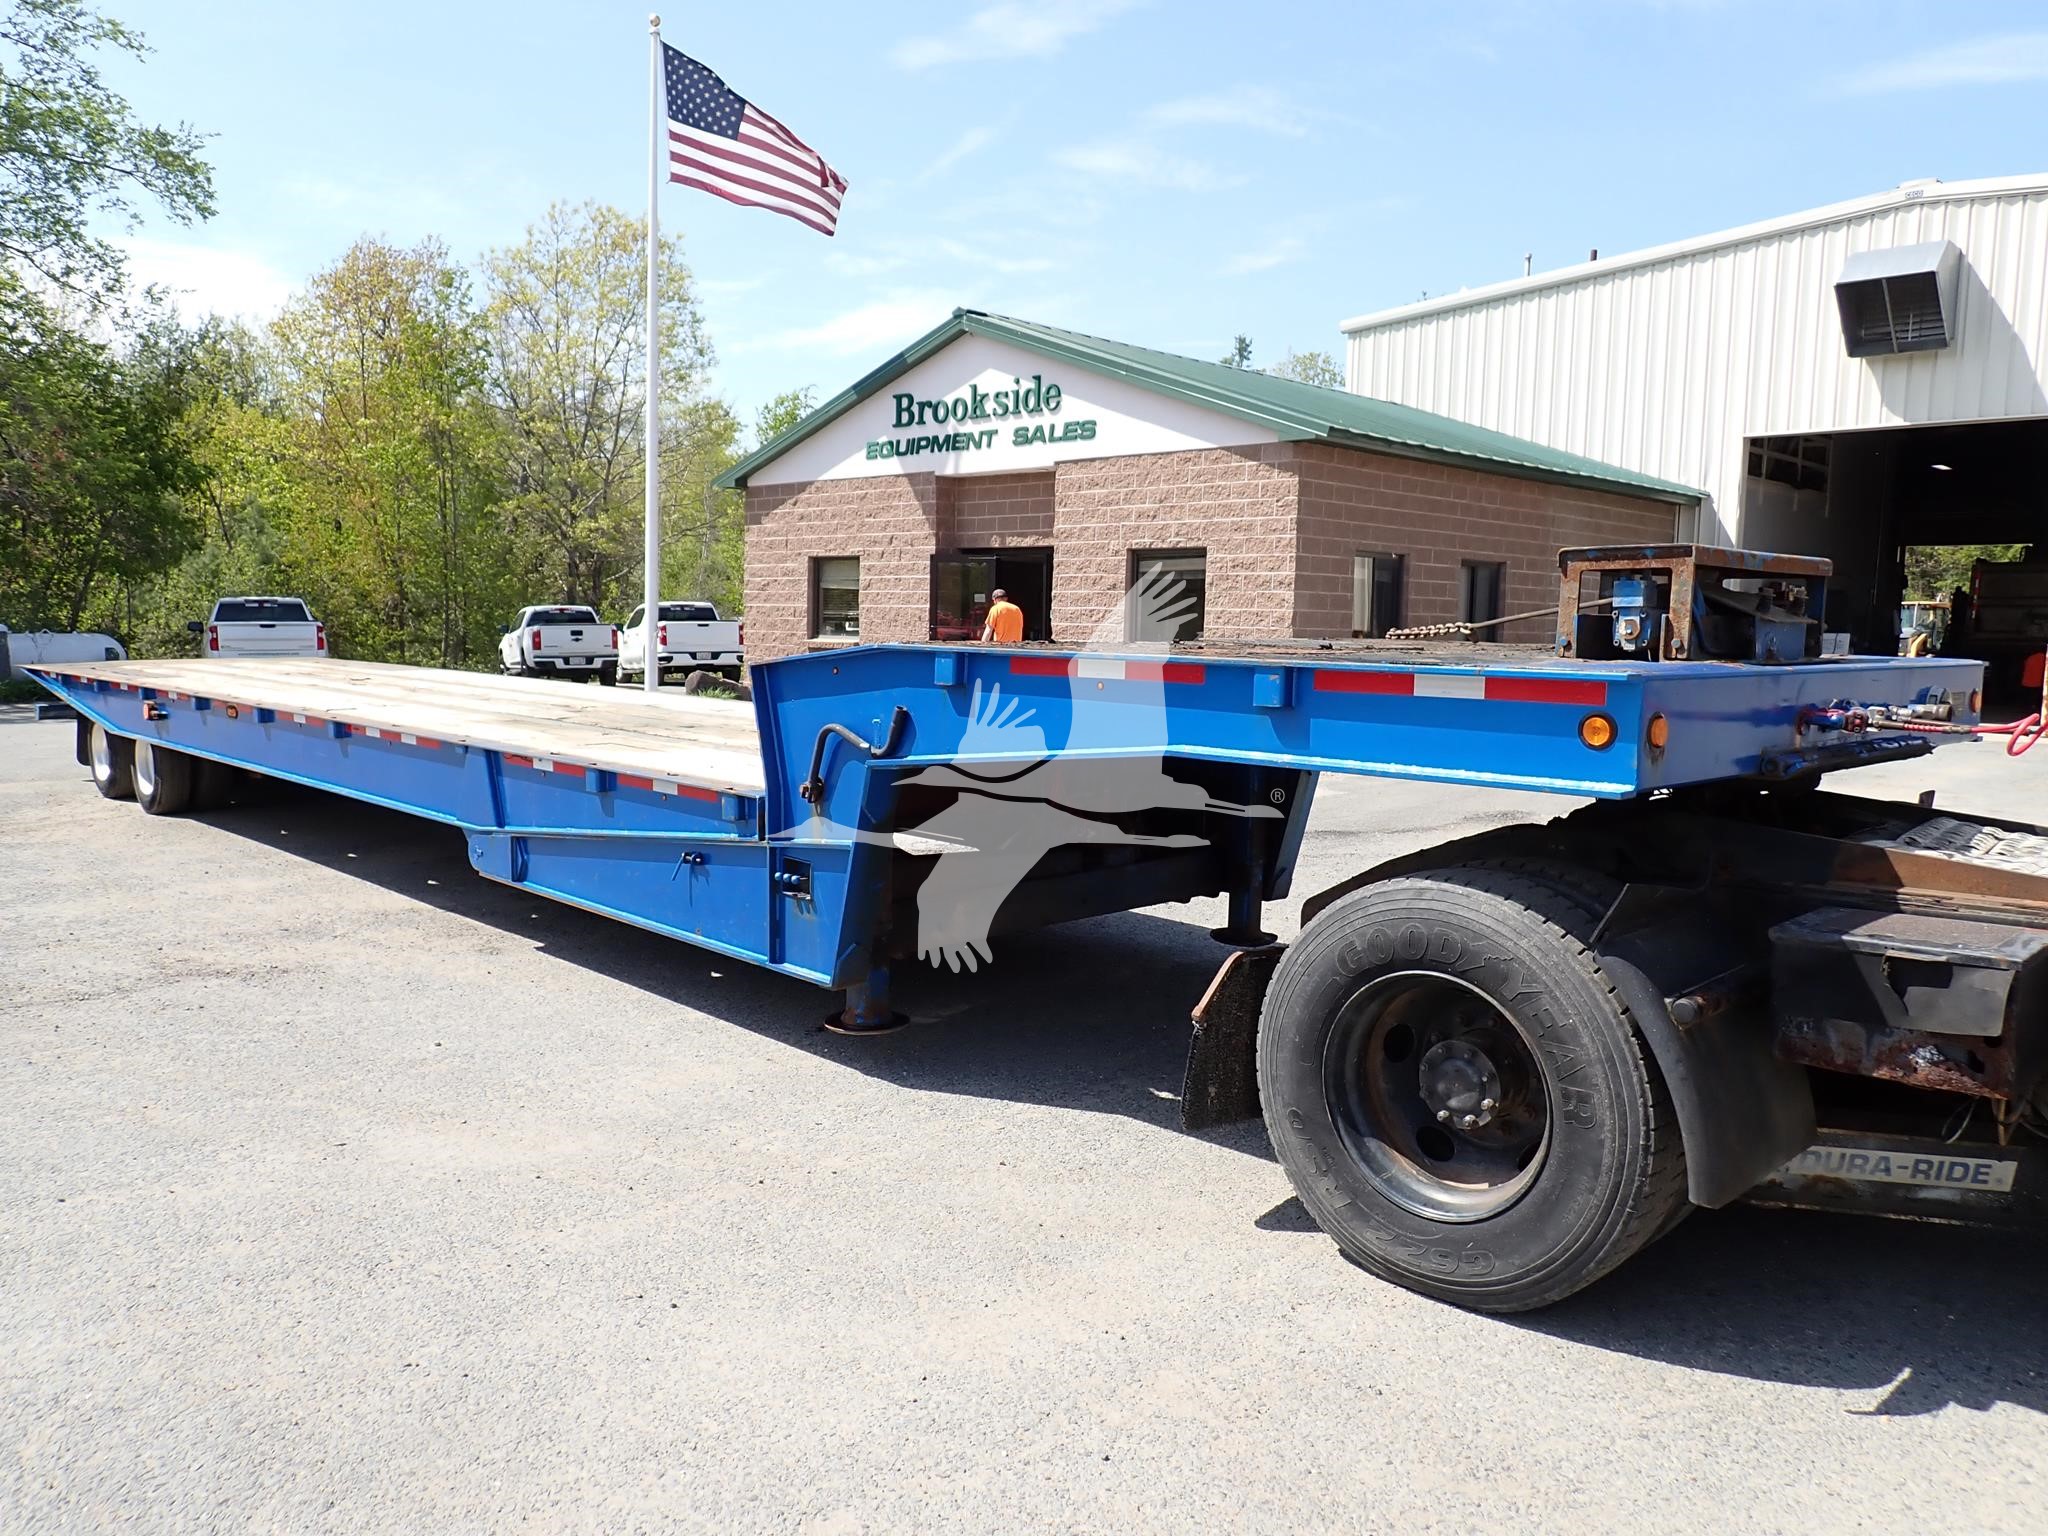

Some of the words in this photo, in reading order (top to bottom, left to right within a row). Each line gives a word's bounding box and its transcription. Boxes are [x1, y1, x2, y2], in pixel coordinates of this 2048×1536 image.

[891, 375, 1062, 428] Brookside
[865, 429, 998, 460] EQUIPMENT
[1012, 420, 1097, 446] SALES
[1800, 1149, 1993, 1185] DURA-RIDE
